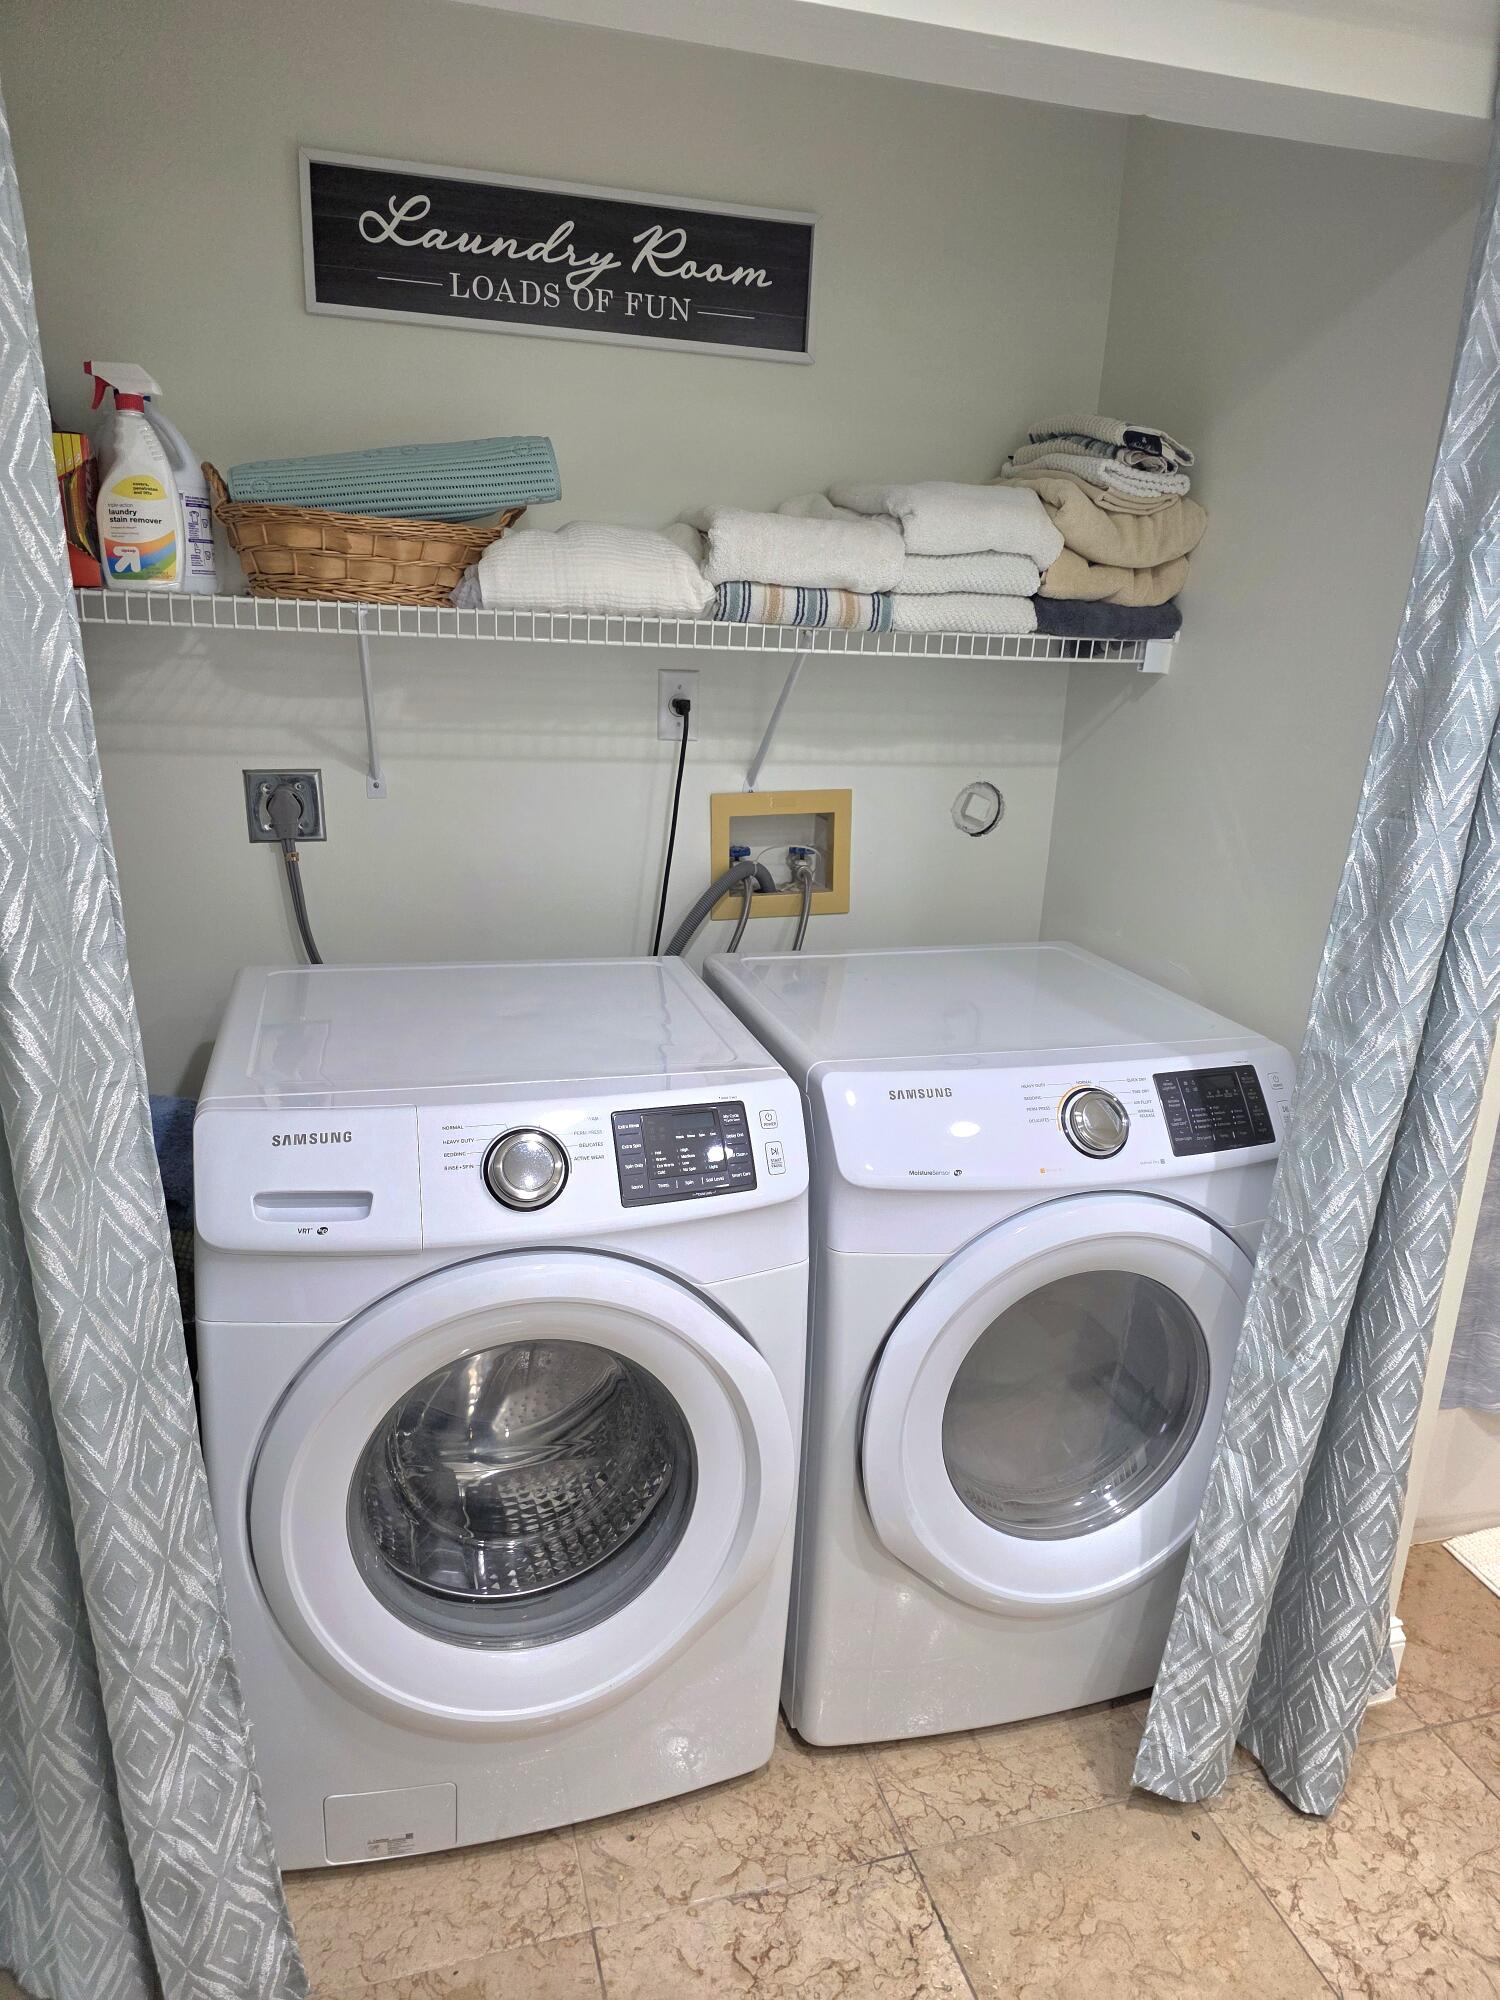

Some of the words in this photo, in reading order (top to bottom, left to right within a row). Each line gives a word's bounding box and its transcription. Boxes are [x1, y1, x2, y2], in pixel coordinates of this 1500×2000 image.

[358, 194, 621, 290] Laundry
[632, 224, 773, 288] Room
[449, 272, 560, 308] LOADS
[573, 287, 614, 313] OF
[624, 291, 691, 322] FUN
[108, 508, 137, 516] laundry
[888, 1087, 952, 1100] SAMSUNG
[271, 1130, 353, 1148] SAMSUNG
